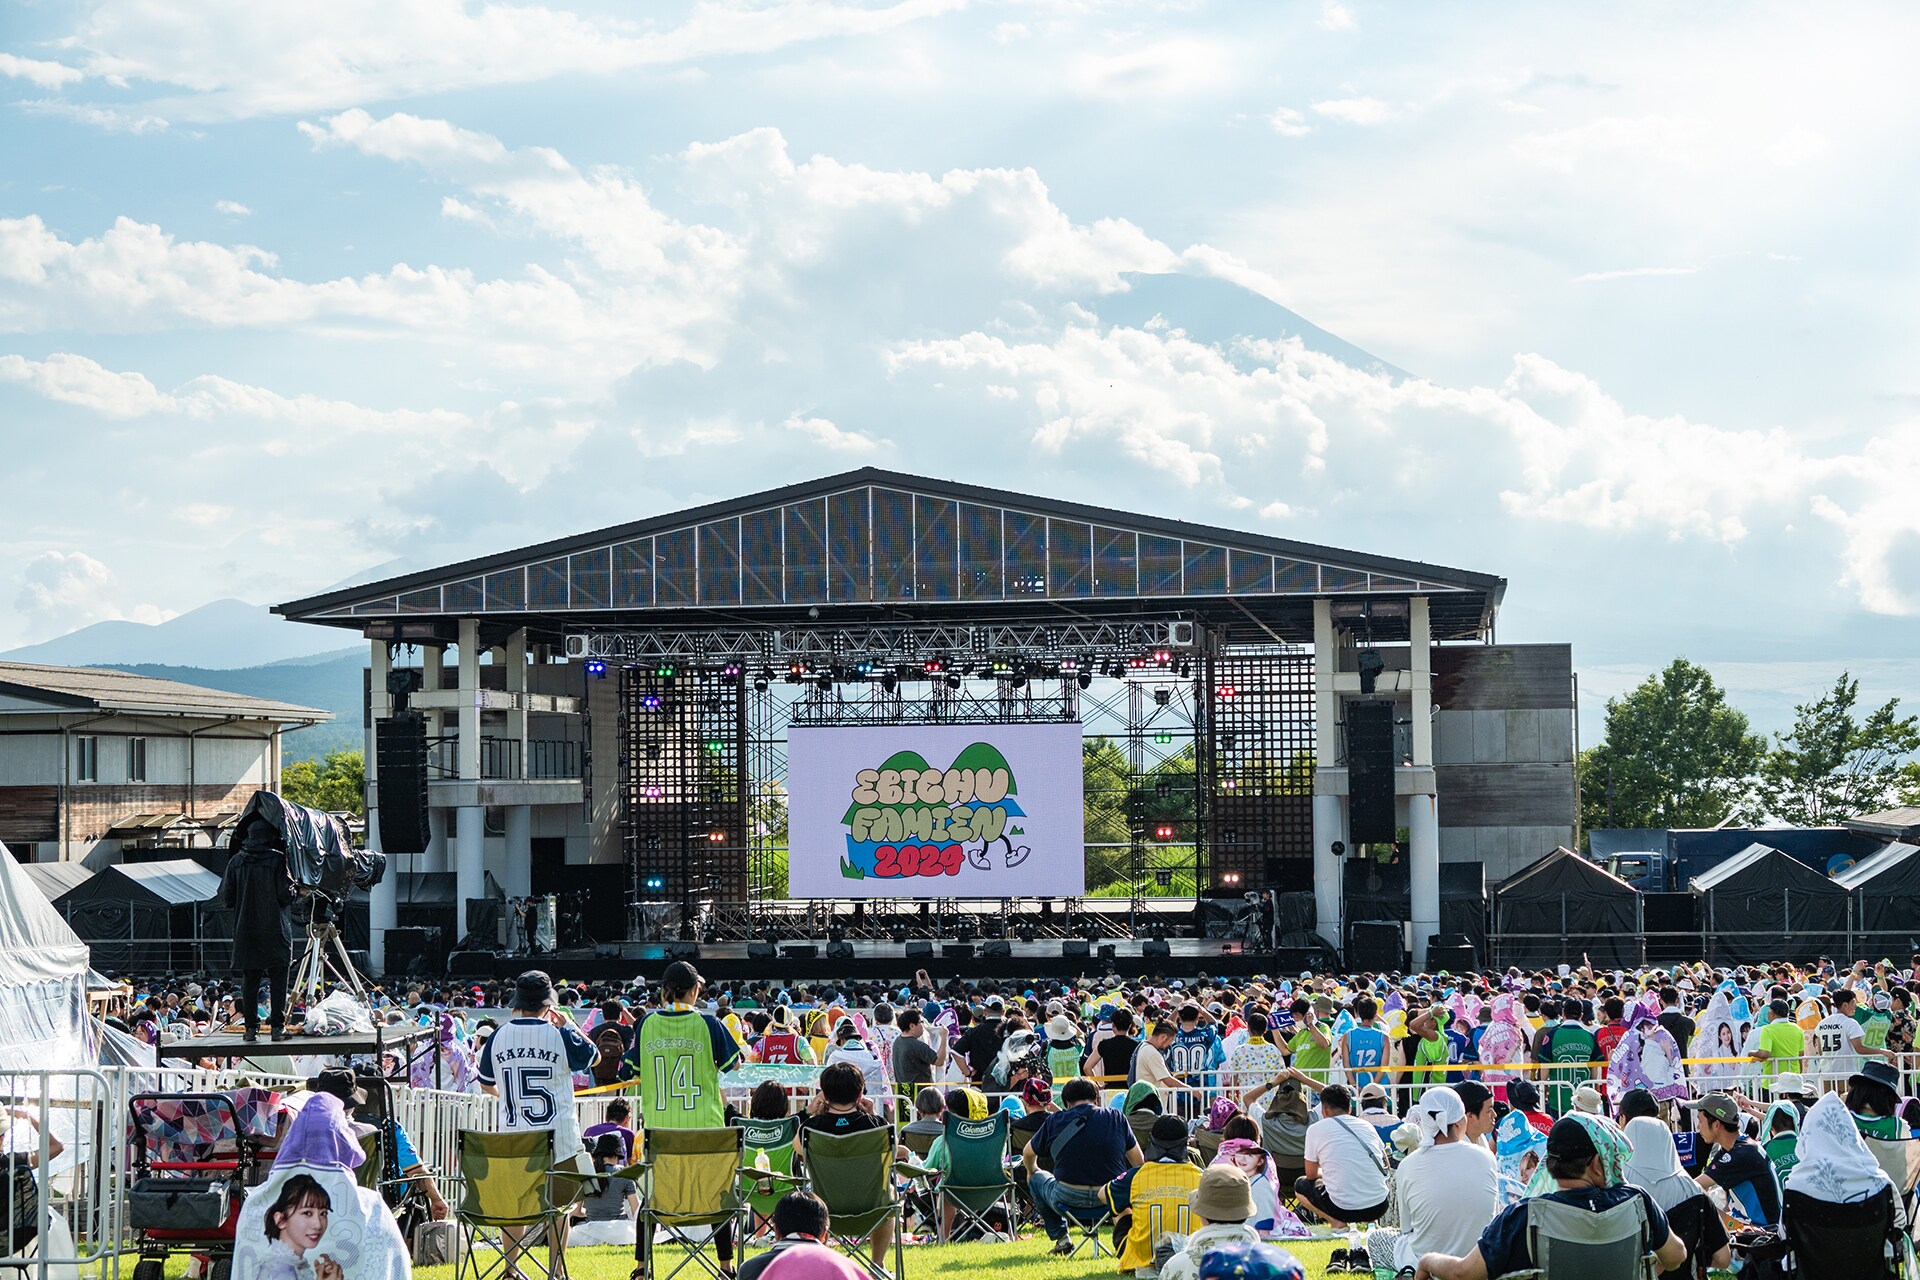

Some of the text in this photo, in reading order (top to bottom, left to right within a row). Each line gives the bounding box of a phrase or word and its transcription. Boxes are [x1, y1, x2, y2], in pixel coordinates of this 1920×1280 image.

[852, 768, 1009, 805] EBICHU
[851, 806, 1007, 843] FAMIEN
[874, 844, 965, 877] 2024
[496, 1047, 560, 1064] KAZAMI
[1356, 1049, 1377, 1066] 12
[1822, 1034, 1842, 1052] 15
[1172, 1044, 1207, 1075] 00
[502, 1067, 557, 1126] 15
[654, 1054, 702, 1110] 14
[747, 1128, 775, 1140] Coleman
[960, 1123, 988, 1134] Coleman
